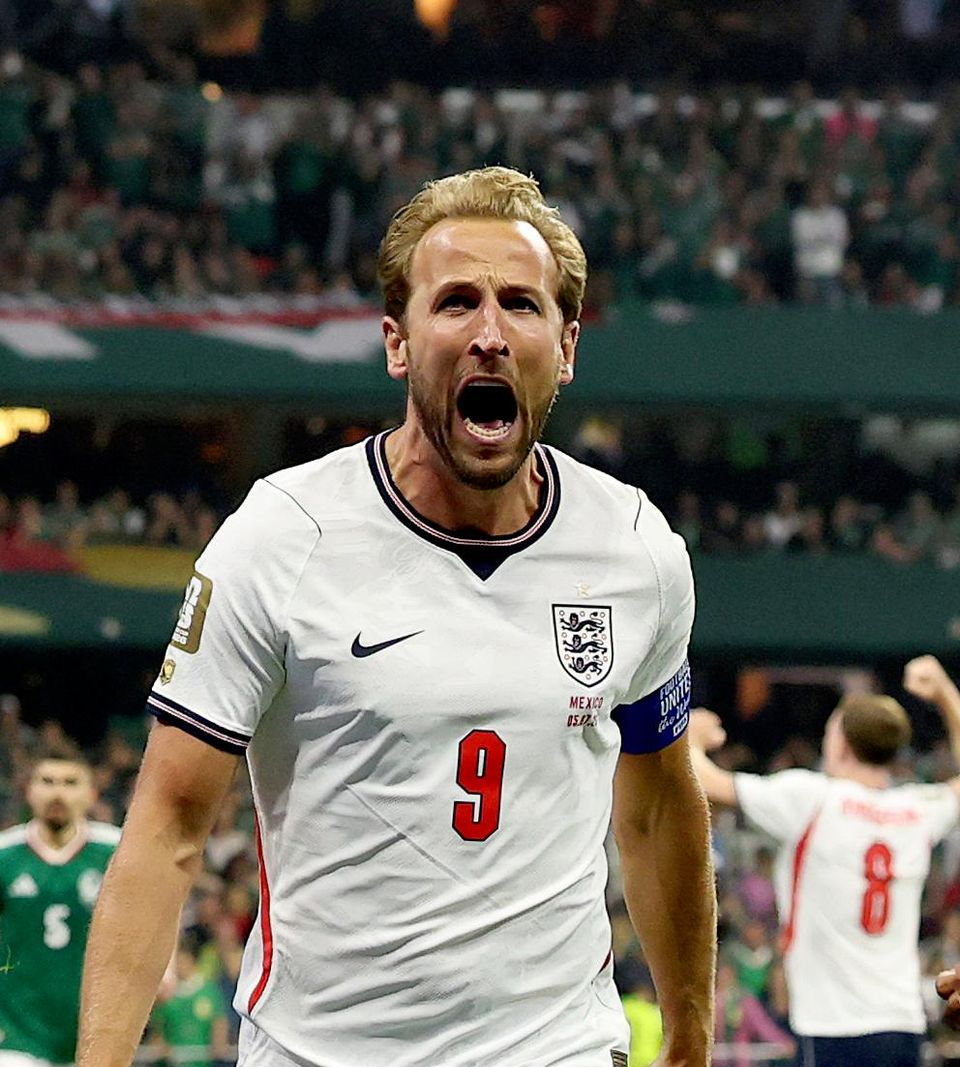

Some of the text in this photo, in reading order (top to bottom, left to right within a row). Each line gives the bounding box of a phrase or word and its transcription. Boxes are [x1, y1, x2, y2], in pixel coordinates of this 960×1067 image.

[452, 729, 506, 841] 9
[43, 904, 71, 949] 5
[862, 843, 893, 934] 8
